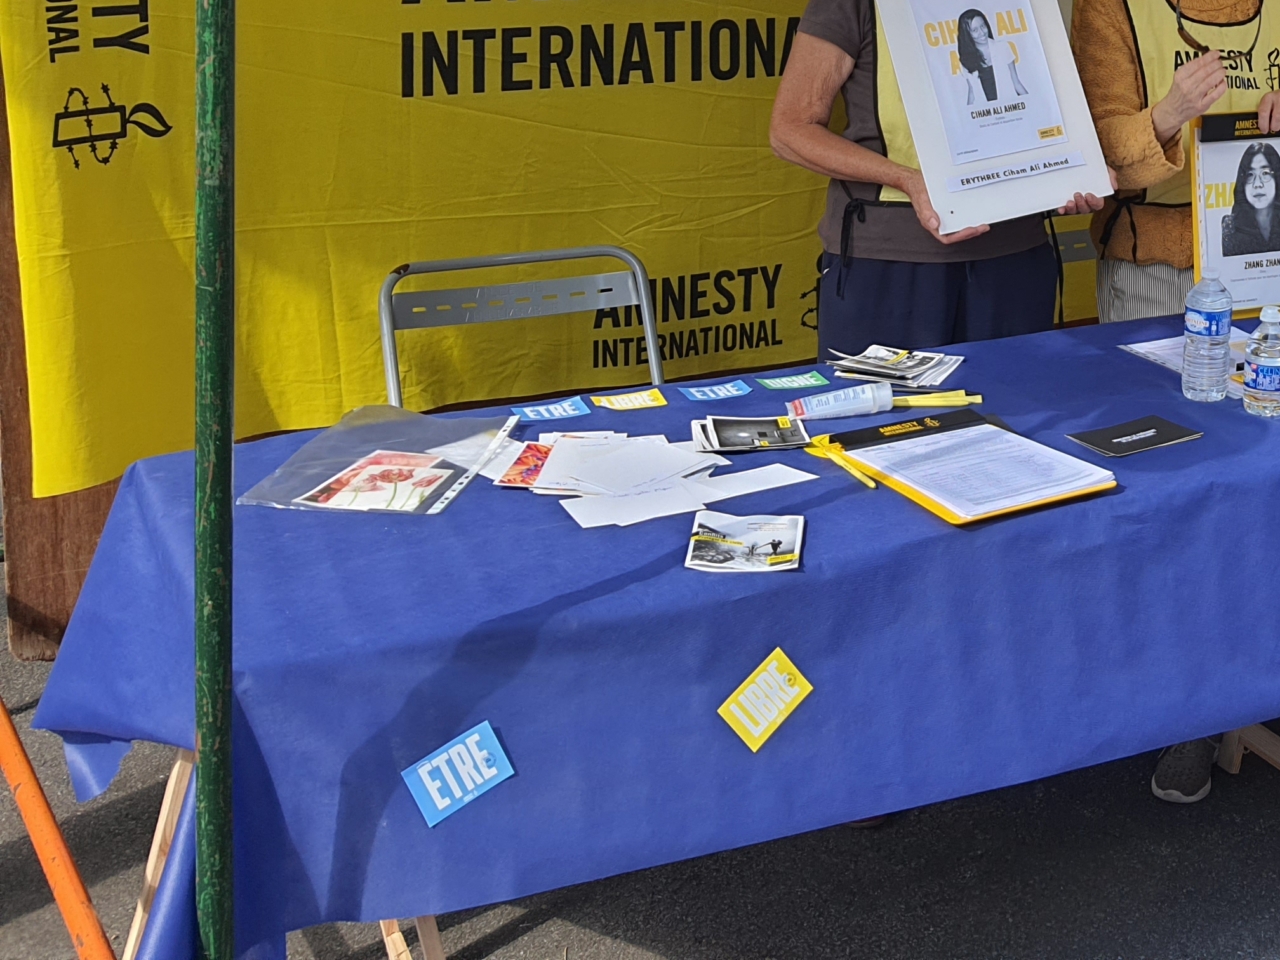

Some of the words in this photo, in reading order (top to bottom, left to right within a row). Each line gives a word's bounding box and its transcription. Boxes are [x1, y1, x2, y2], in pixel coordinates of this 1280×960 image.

[994, 8, 1029, 37] ALI
[400, 17, 801, 98] INTERNATIONA
[970, 108, 992, 120] CIHAM
[993, 105, 1004, 116] ALI
[1004, 102, 1027, 114] AHMED
[1235, 119, 1258, 130] AMNES
[960, 172, 1001, 186] ERYTHREE
[1003, 166, 1028, 178] Ciham
[1029, 163, 1041, 172] Ali
[1043, 158, 1070, 171] Ahmed
[1244, 259, 1264, 270] ZHANG
[1265, 258, 1280, 268] ZHAN
[592, 318, 783, 369] INTERNATIONAL
[600, 390, 658, 410] LIBRE
[729, 659, 801, 738] LIBRE
